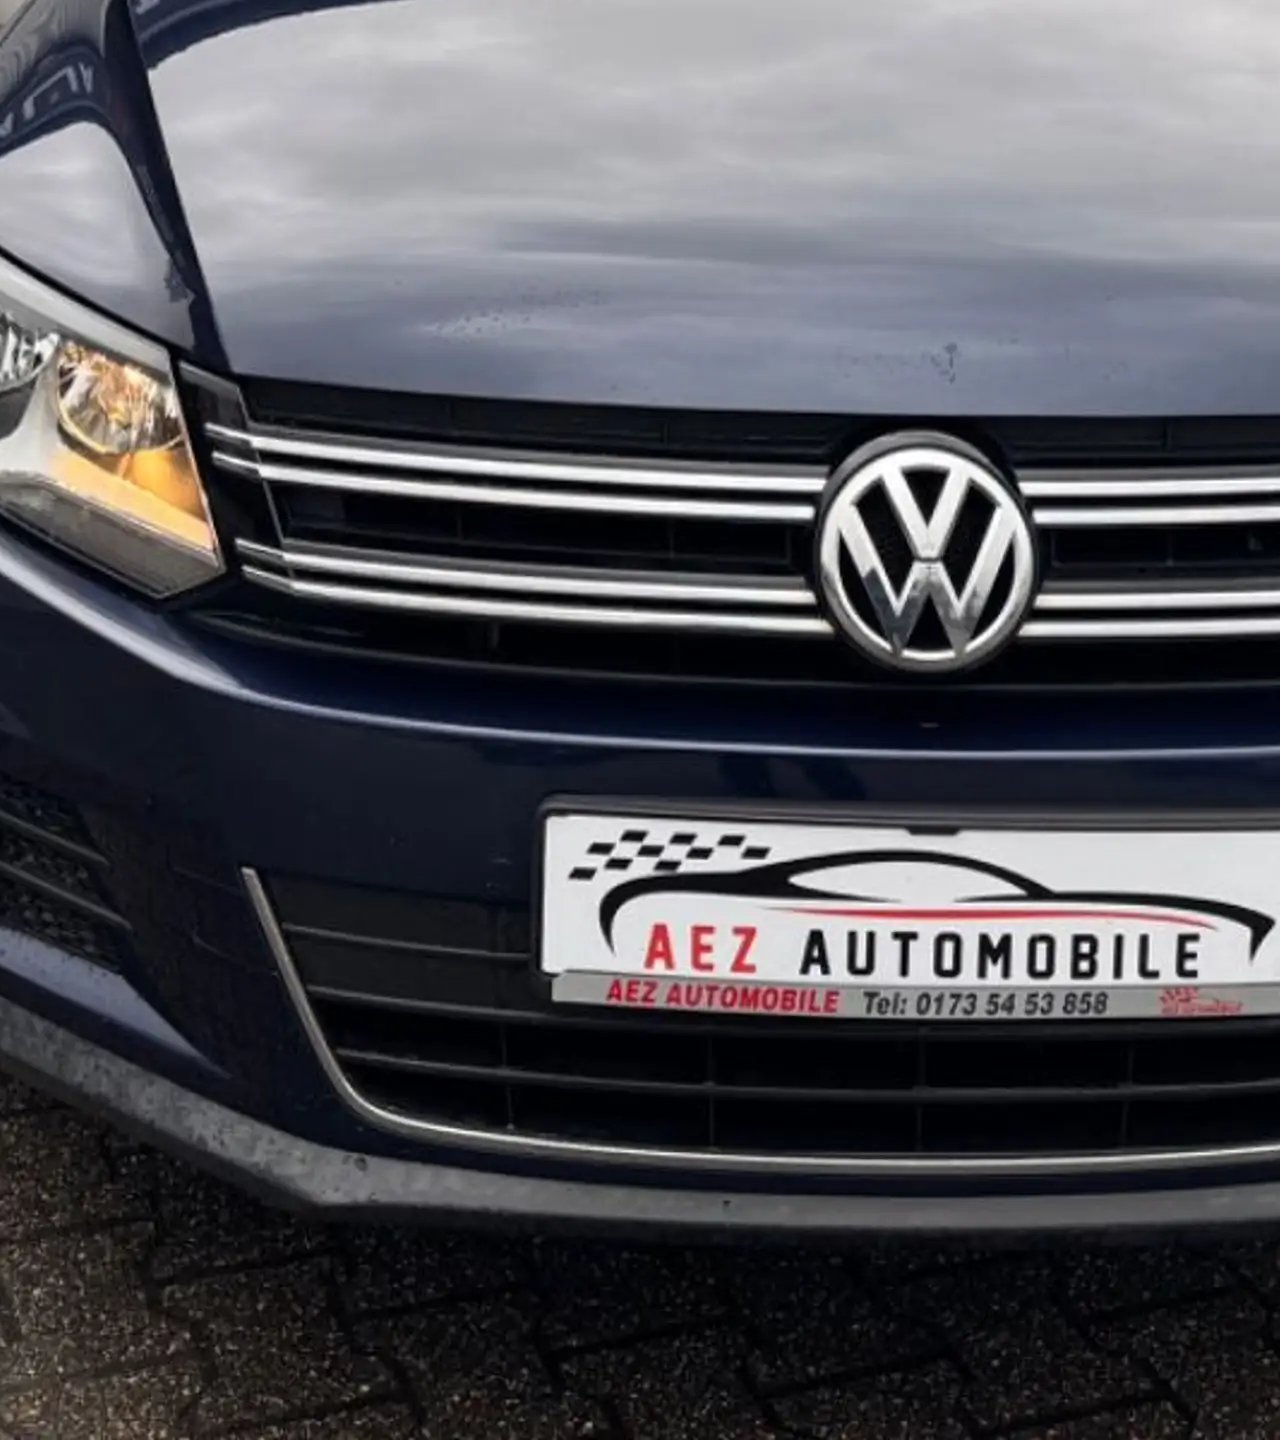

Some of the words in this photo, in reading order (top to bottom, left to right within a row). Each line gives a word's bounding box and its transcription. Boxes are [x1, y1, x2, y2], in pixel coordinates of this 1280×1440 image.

[823, 446, 1032, 666] VW
[644, 923, 759, 974] AEZ
[800, 930, 1200, 981] AUTOMOBILE
[605, 978, 658, 1004] AEZ
[664, 982, 841, 1014] AUTOMOBILE
[862, 990, 907, 1016] Tel:
[916, 991, 977, 1017] 0173
[985, 991, 1016, 1017] 54
[1024, 991, 1055, 1016] 53
[1062, 990, 1109, 1016] 858
